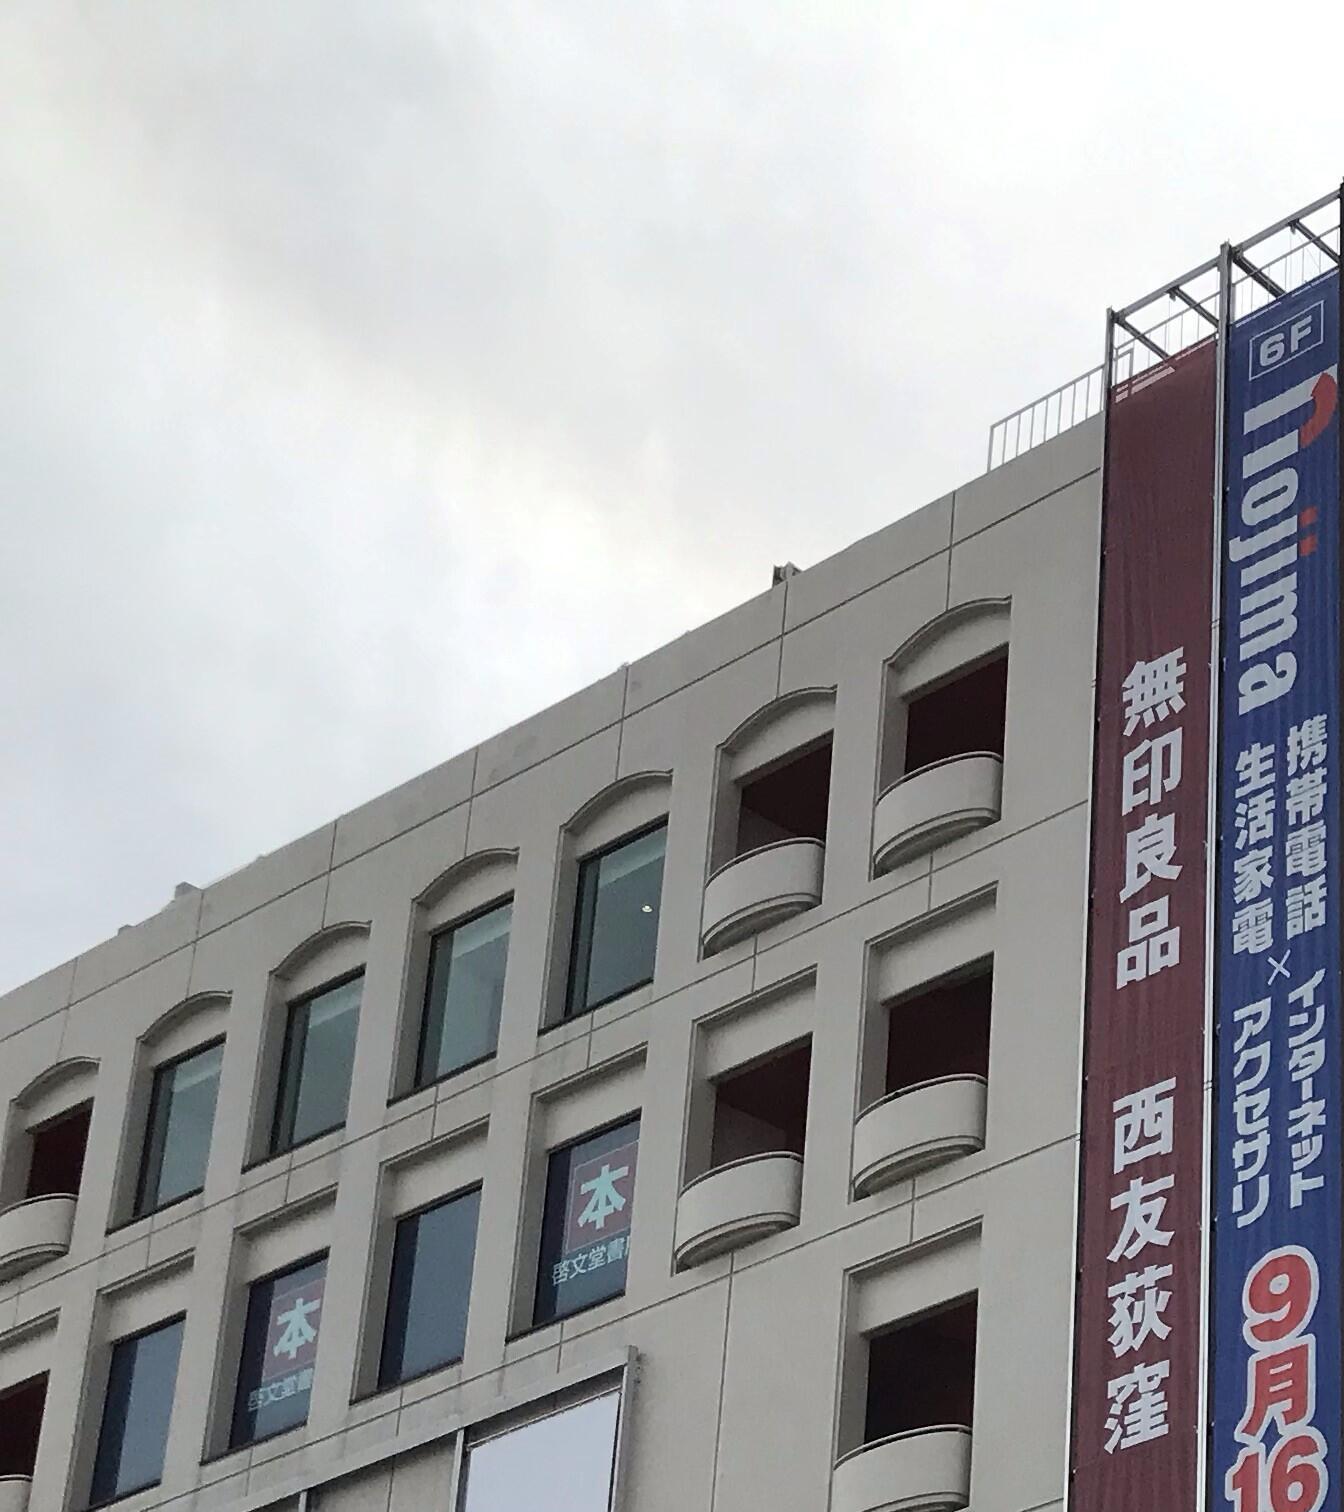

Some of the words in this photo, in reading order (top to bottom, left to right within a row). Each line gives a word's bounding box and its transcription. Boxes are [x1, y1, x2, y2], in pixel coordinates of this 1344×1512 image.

[1259, 313, 1316, 367] 6F
[1116, 646, 1187, 991] 無印良品
[577, 1162, 630, 1231] 本
[1103, 1076, 1177, 1456] 西友荻窪
[273, 1297, 319, 1360] 本
